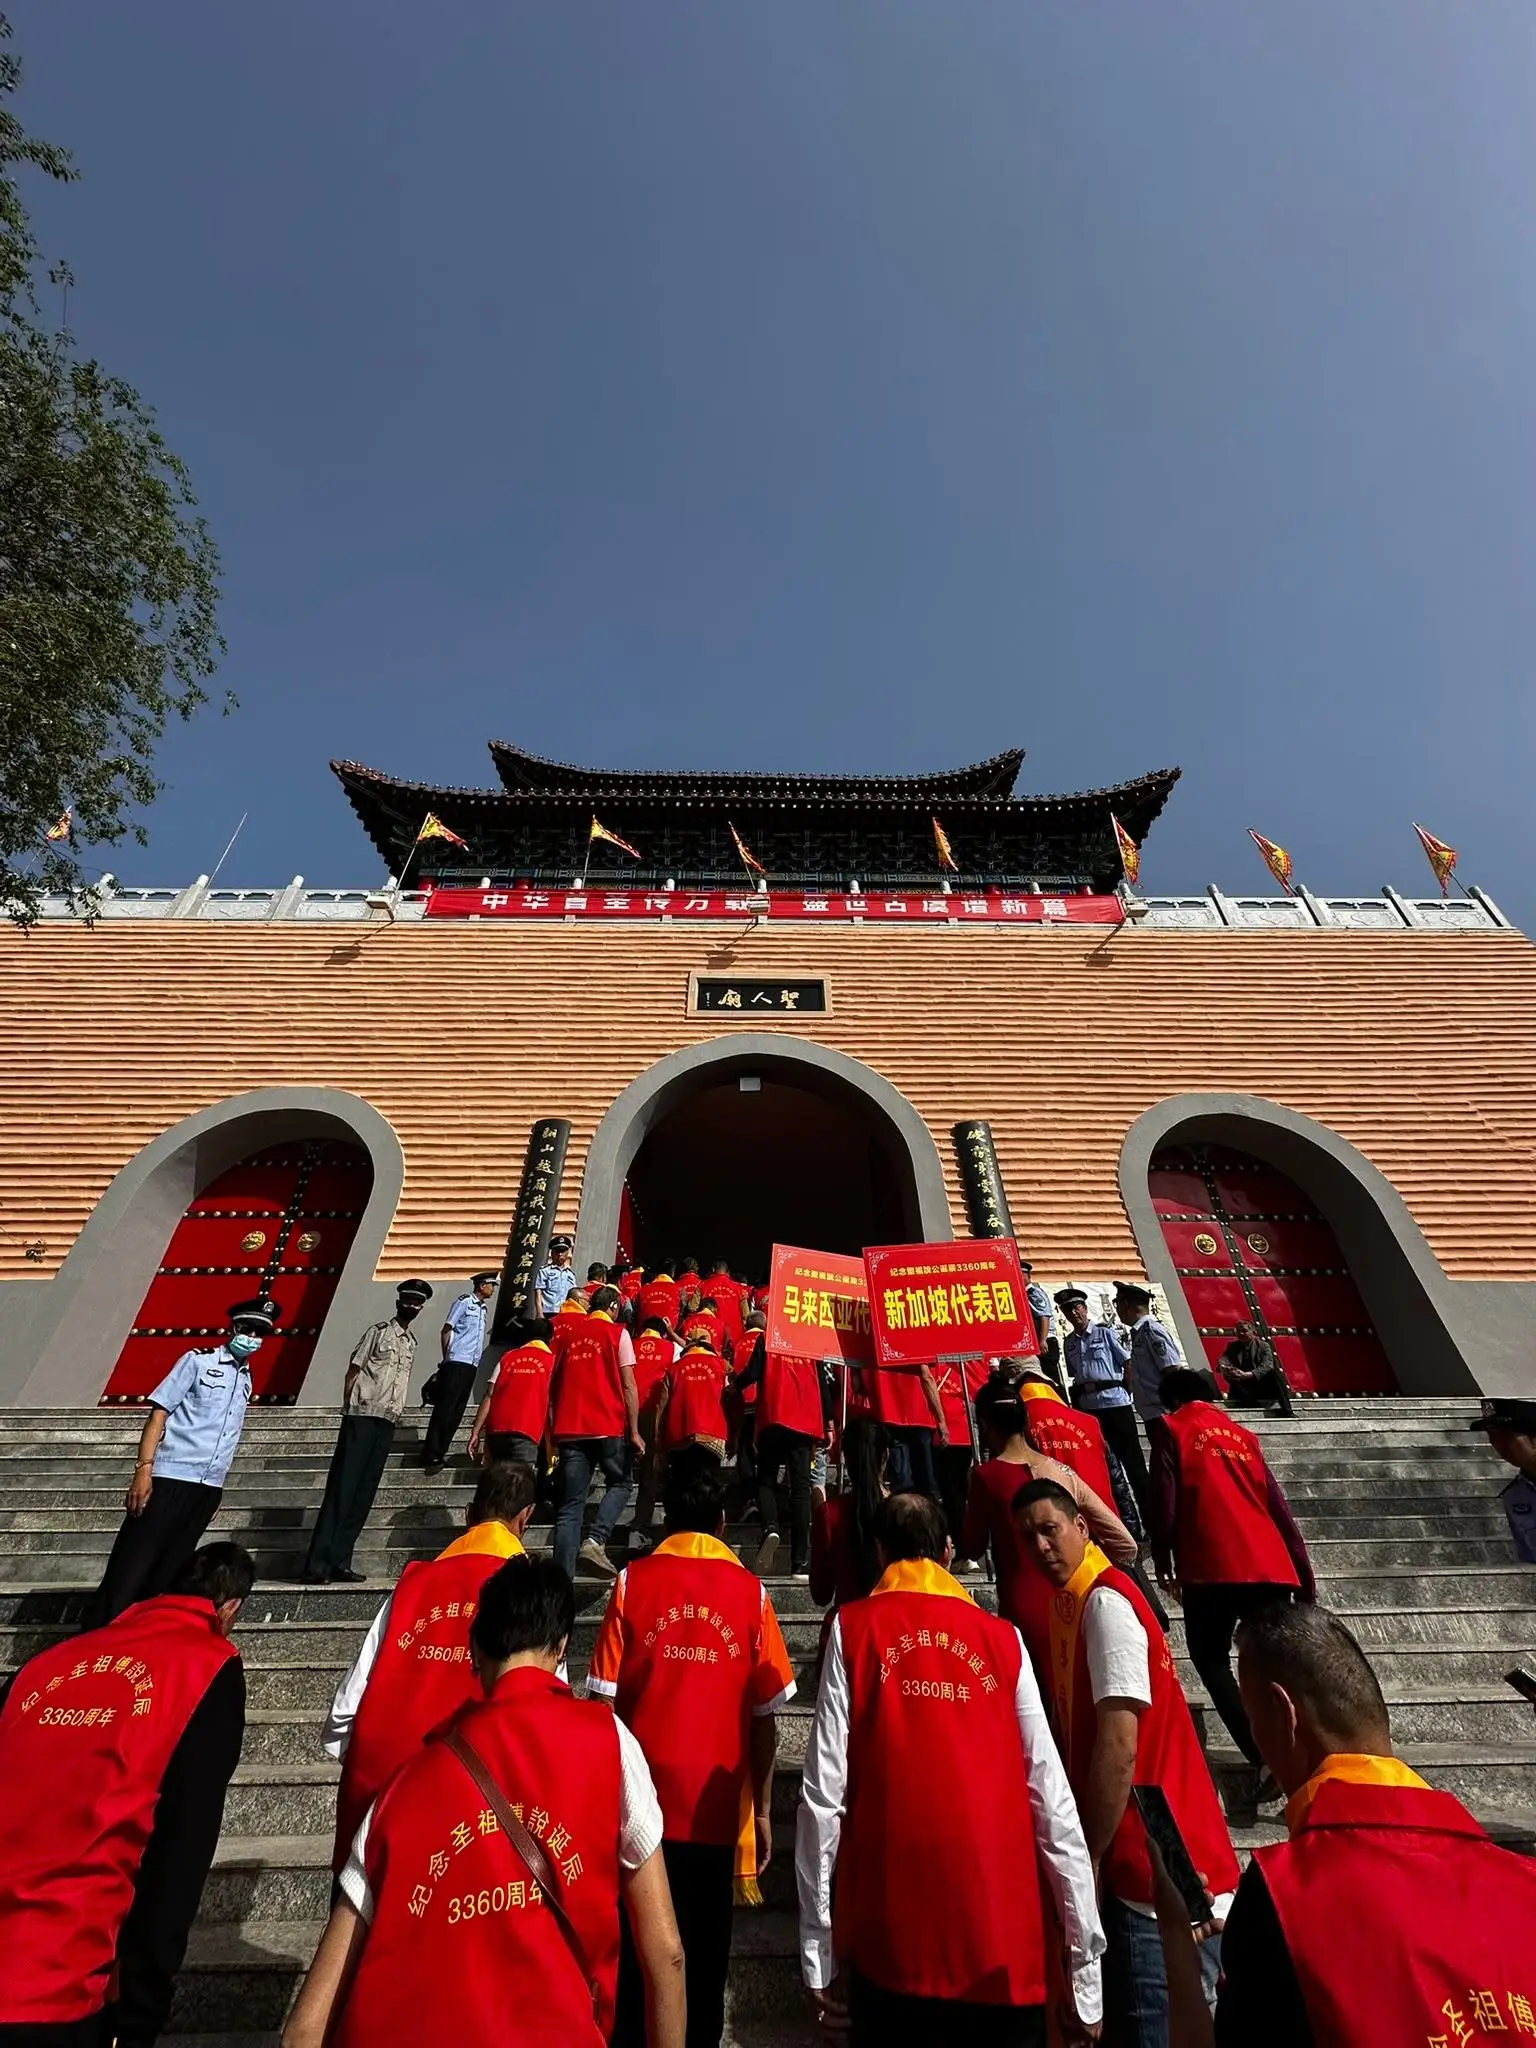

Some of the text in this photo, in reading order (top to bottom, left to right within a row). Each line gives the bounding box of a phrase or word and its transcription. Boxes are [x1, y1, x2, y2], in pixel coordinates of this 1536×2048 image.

[884, 1281, 1018, 1330] 新加坡代表团
[663, 1644, 719, 1665] 3360周年
[902, 1679, 972, 1703] 3360周年
[38, 1706, 118, 1728] 3360周年
[447, 1878, 544, 1925] 3360周年
[1426, 1988, 1536, 2048] 圣祖傅
